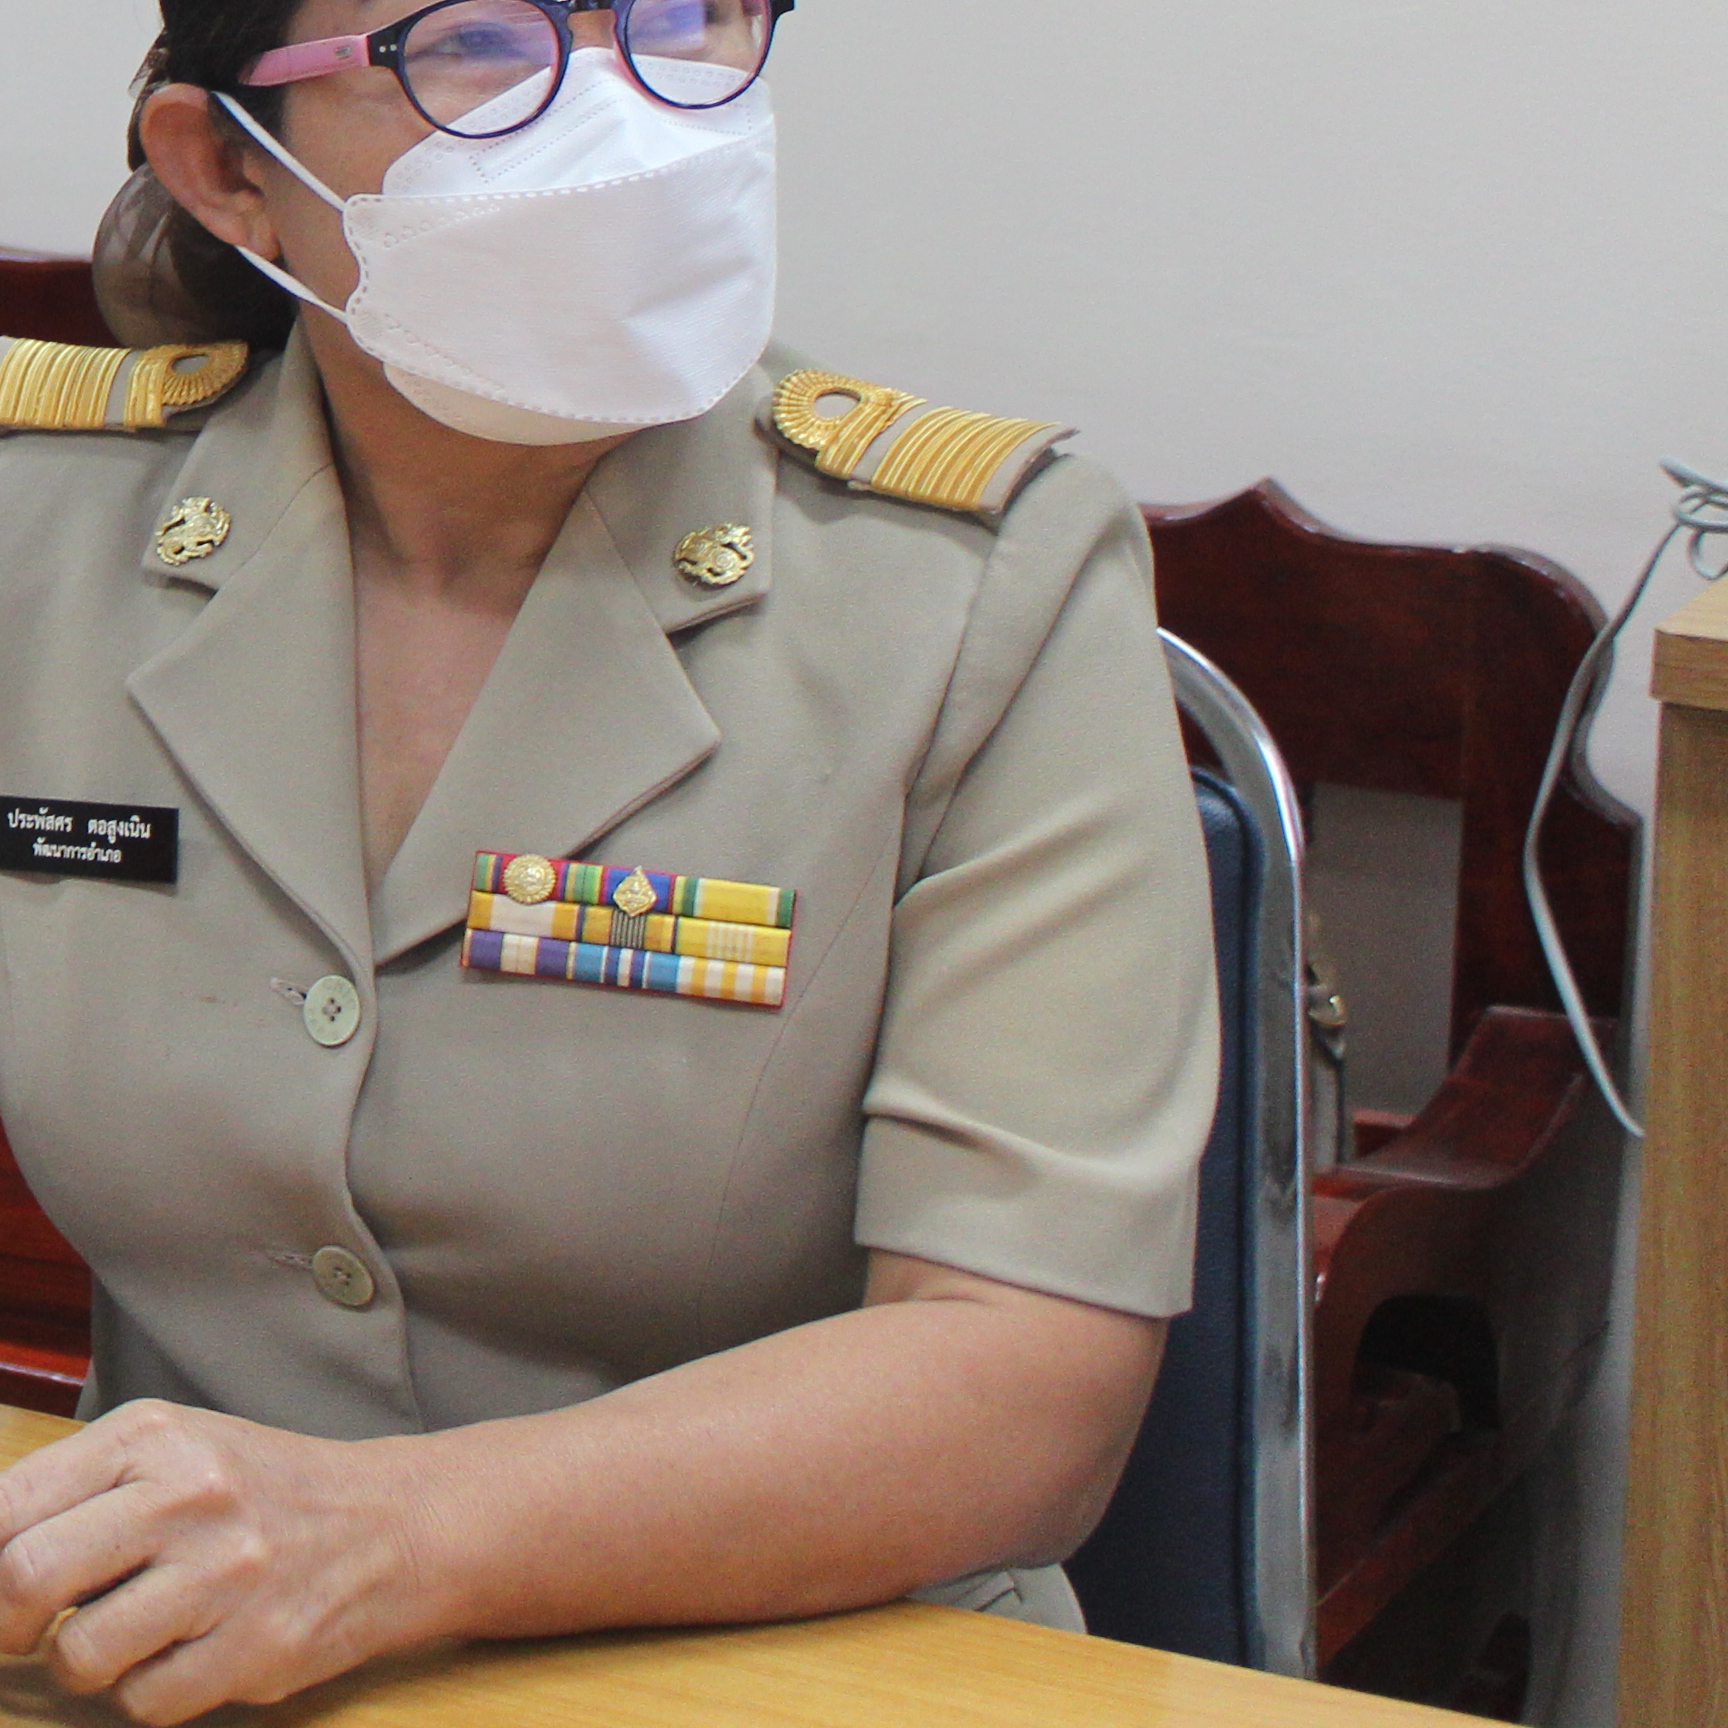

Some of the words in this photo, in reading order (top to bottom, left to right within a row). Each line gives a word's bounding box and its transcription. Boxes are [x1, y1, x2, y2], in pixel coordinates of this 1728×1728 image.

[32, 835, 123, 864] พัฒนาการอำเภอ
